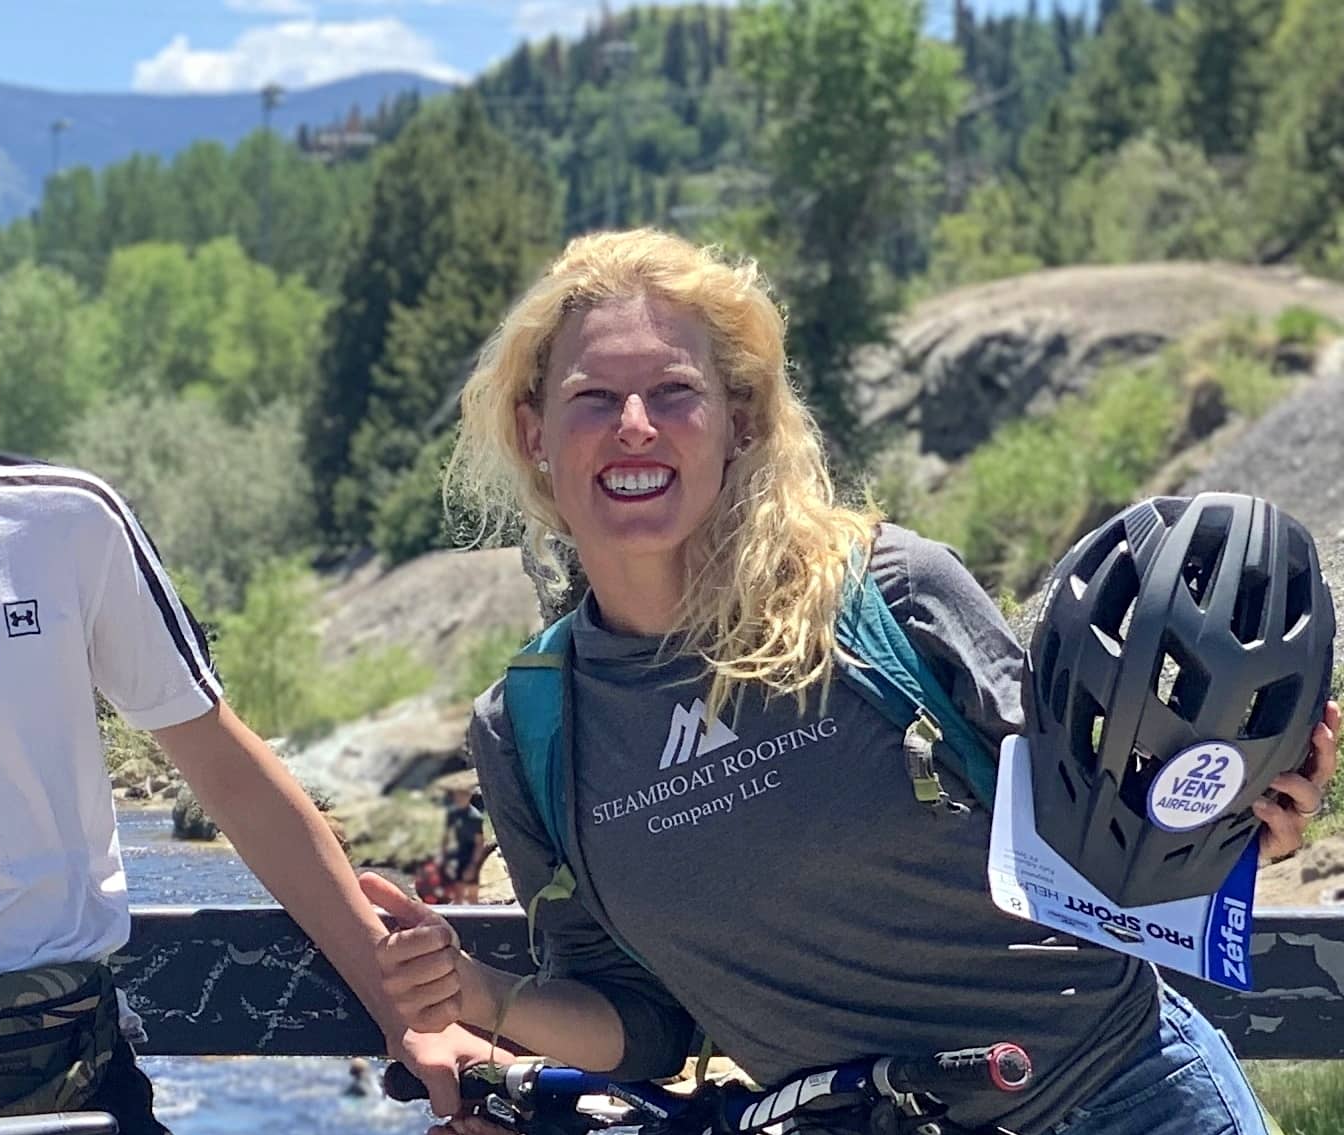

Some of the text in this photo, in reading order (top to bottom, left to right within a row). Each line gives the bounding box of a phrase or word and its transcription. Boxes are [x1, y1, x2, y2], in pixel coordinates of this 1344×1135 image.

[592, 717, 838, 825] STEAMBOAT ROOFING
[1171, 777, 1226, 800] VENT
[1187, 753, 1230, 781] 22
[647, 770, 782, 834] Company LLC
[1155, 796, 1218, 815] AIRFLOW!
[1064, 895, 1142, 932] SPORT
[1146, 923, 1194, 950] PRO
[1222, 896, 1247, 985] Zéfal
